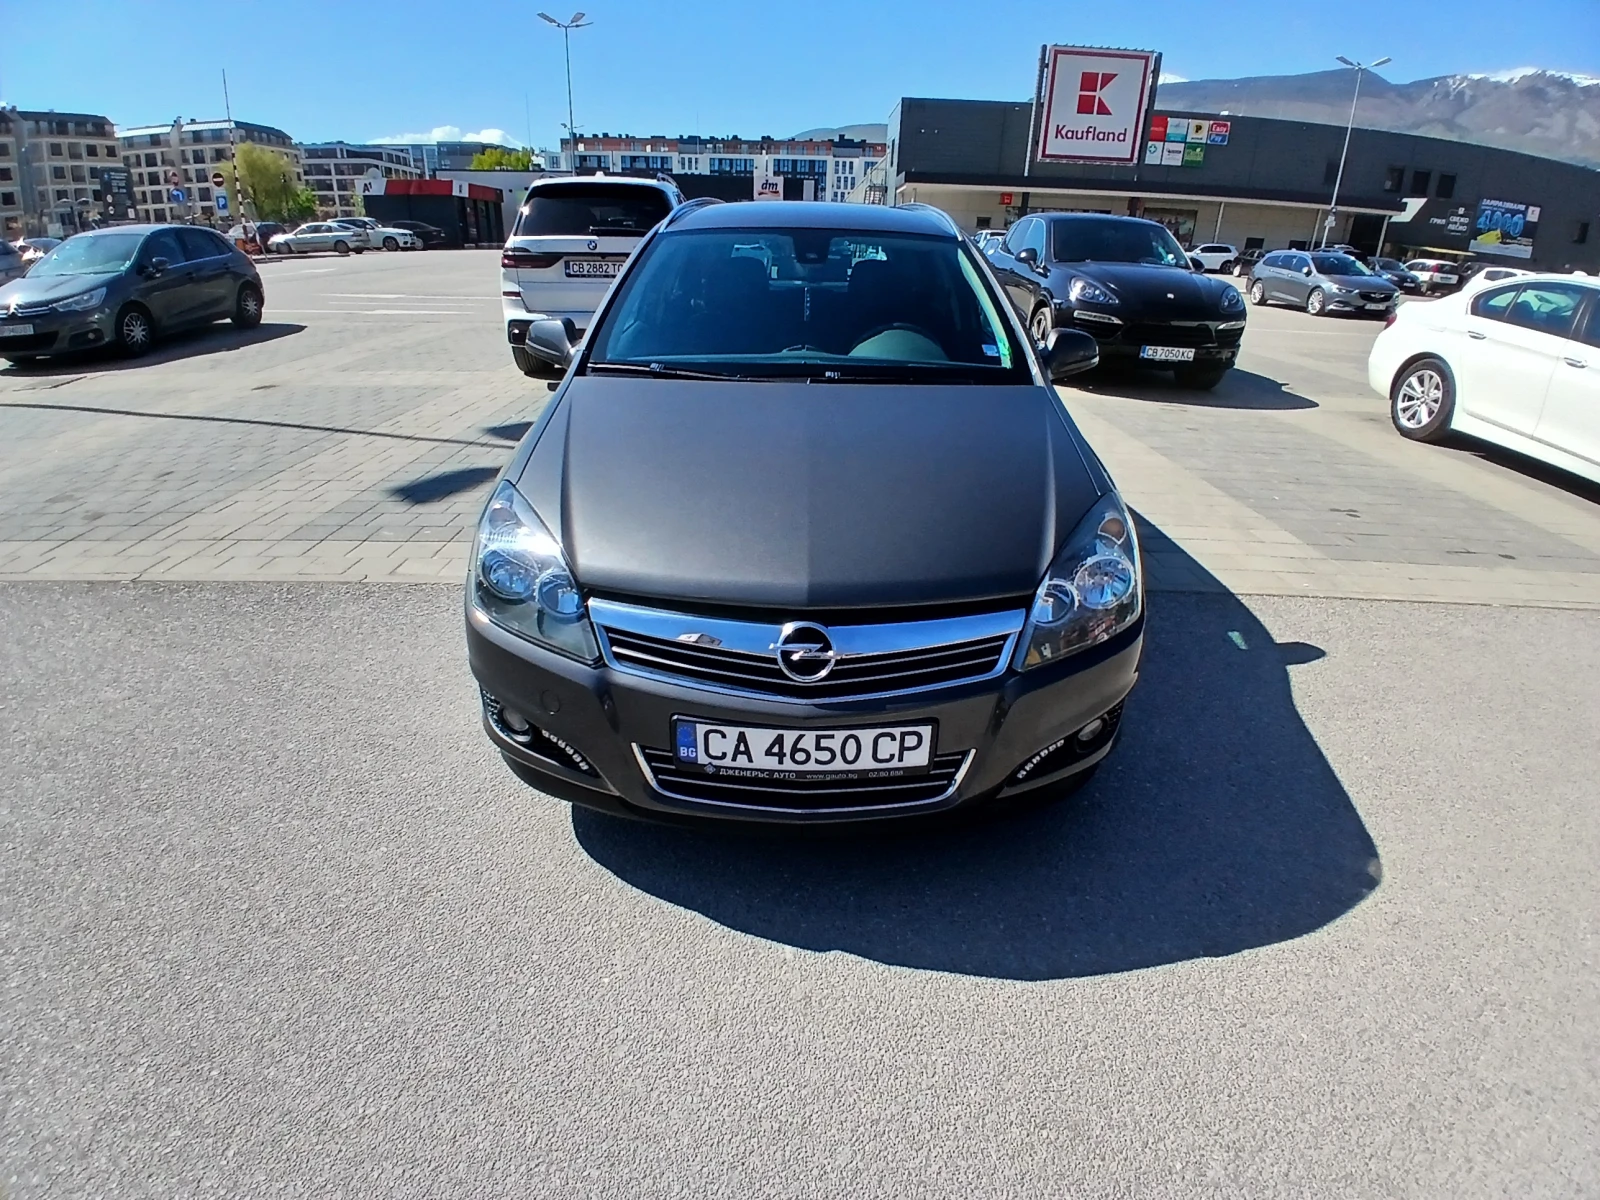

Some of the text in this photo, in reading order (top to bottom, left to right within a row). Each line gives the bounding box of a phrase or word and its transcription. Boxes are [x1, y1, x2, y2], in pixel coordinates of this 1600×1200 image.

[1054, 124, 1127, 142] Kaufland
[1212, 124, 1227, 133] Easy
[1210, 135, 1223, 143] Pay
[362, 181, 373, 194] A1
[761, 179, 778, 190] dm
[572, 263, 585, 273] CB
[586, 263, 610, 274] 2882
[1146, 347, 1193, 360] CB 7050 KC
[679, 746, 697, 758] BG
[703, 728, 923, 766] CA 4650 CP
[773, 771, 797, 780] АУТО
[806, 771, 858, 781] www.gauto.bg
